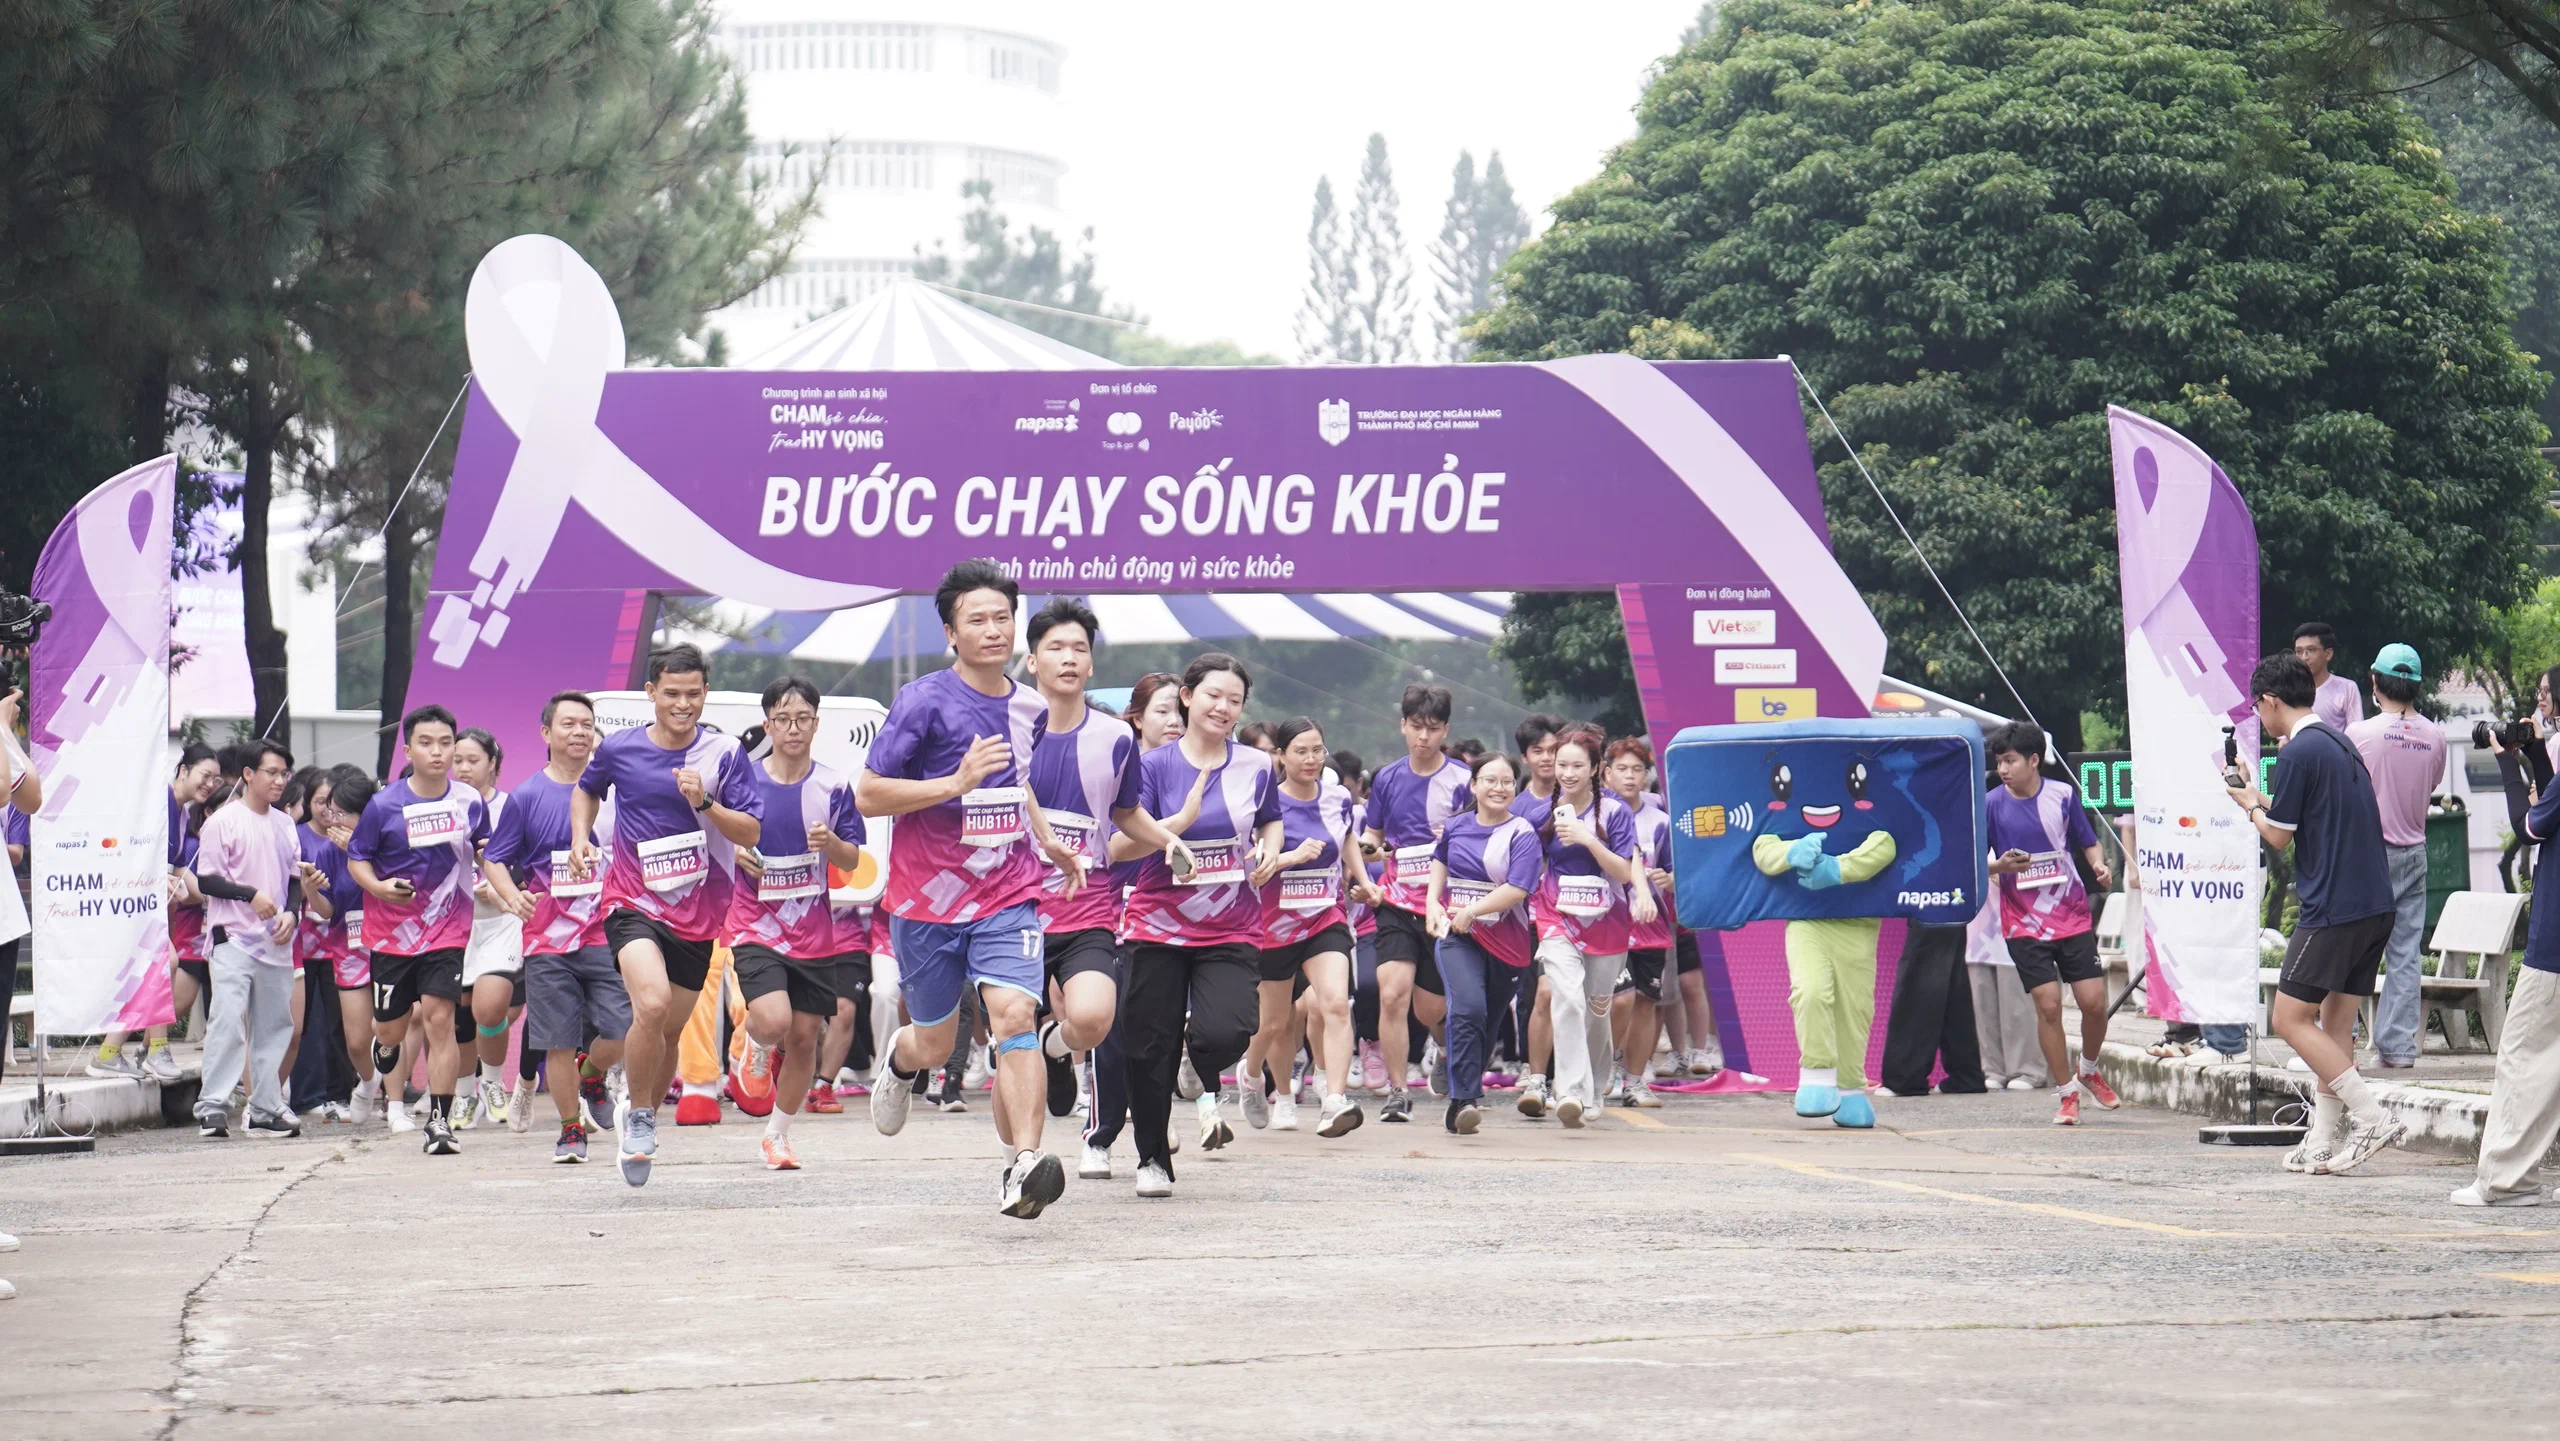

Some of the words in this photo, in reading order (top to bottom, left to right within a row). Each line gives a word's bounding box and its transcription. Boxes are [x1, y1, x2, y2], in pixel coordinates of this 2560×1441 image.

[762, 387, 799, 400] Chương
[801, 387, 822, 398] trình
[824, 389, 836, 398] an
[838, 388, 857, 398] sinh
[859, 388, 870, 398] xã
[872, 388, 887, 400] hội
[770, 404, 826, 427] CHẠM
[1357, 408, 1399, 420] TRƯỜNG
[1420, 410, 1442, 420] HỌC
[1443, 408, 1472, 419] NGÂN
[1473, 407, 1502, 418] HÀNG
[1015, 416, 1064, 435] napas
[1169, 411, 1211, 435] Payoo
[1357, 419, 1392, 431] THÀNH
[1452, 419, 1479, 429] MINH
[801, 430, 827, 448] HY
[831, 430, 884, 453] VỌNG
[758, 462, 937, 538] BƯỚC
[953, 474, 1127, 550] CHẠY
[1138, 456, 1315, 537] SỐNG
[1331, 451, 1506, 536] KHỎE
[1028, 556, 1075, 579] trình
[1080, 553, 1118, 579] chủ
[1122, 555, 1174, 587] động
[1179, 556, 1197, 579] vì
[1201, 553, 1240, 579] sức
[1244, 552, 1295, 579] khỏe
[1686, 587, 1706, 599] Đơn
[1708, 587, 1717, 600] vị
[1719, 586, 1744, 602] đồng
[1746, 587, 1771, 599] hành
[1761, 696, 1788, 717] be
[594, 715, 655, 727] masterc
[408, 818, 451, 835] HUB157
[966, 813, 1016, 830] HUB119
[55, 841, 81, 850] napas
[643, 856, 696, 877] HUB402
[1196, 854, 1229, 869] B061
[1398, 861, 1433, 874] HUB322
[2139, 848, 2184, 874] CHẠM
[761, 872, 808, 886] HUB152
[2017, 864, 2057, 880] HUB022
[46, 872, 103, 895] CHẠM
[1282, 883, 1325, 896] HUB057
[2160, 879, 2184, 898] HY
[2191, 880, 2244, 904] VỌNG
[79, 899, 104, 917] HY
[110, 893, 158, 919] VỌNG
[1451, 893, 1485, 905] HUB4
[1559, 891, 1600, 904] HUB206
[1897, 891, 1950, 910] napas
[1021, 929, 1042, 958] 17
[373, 981, 395, 1010] 17
